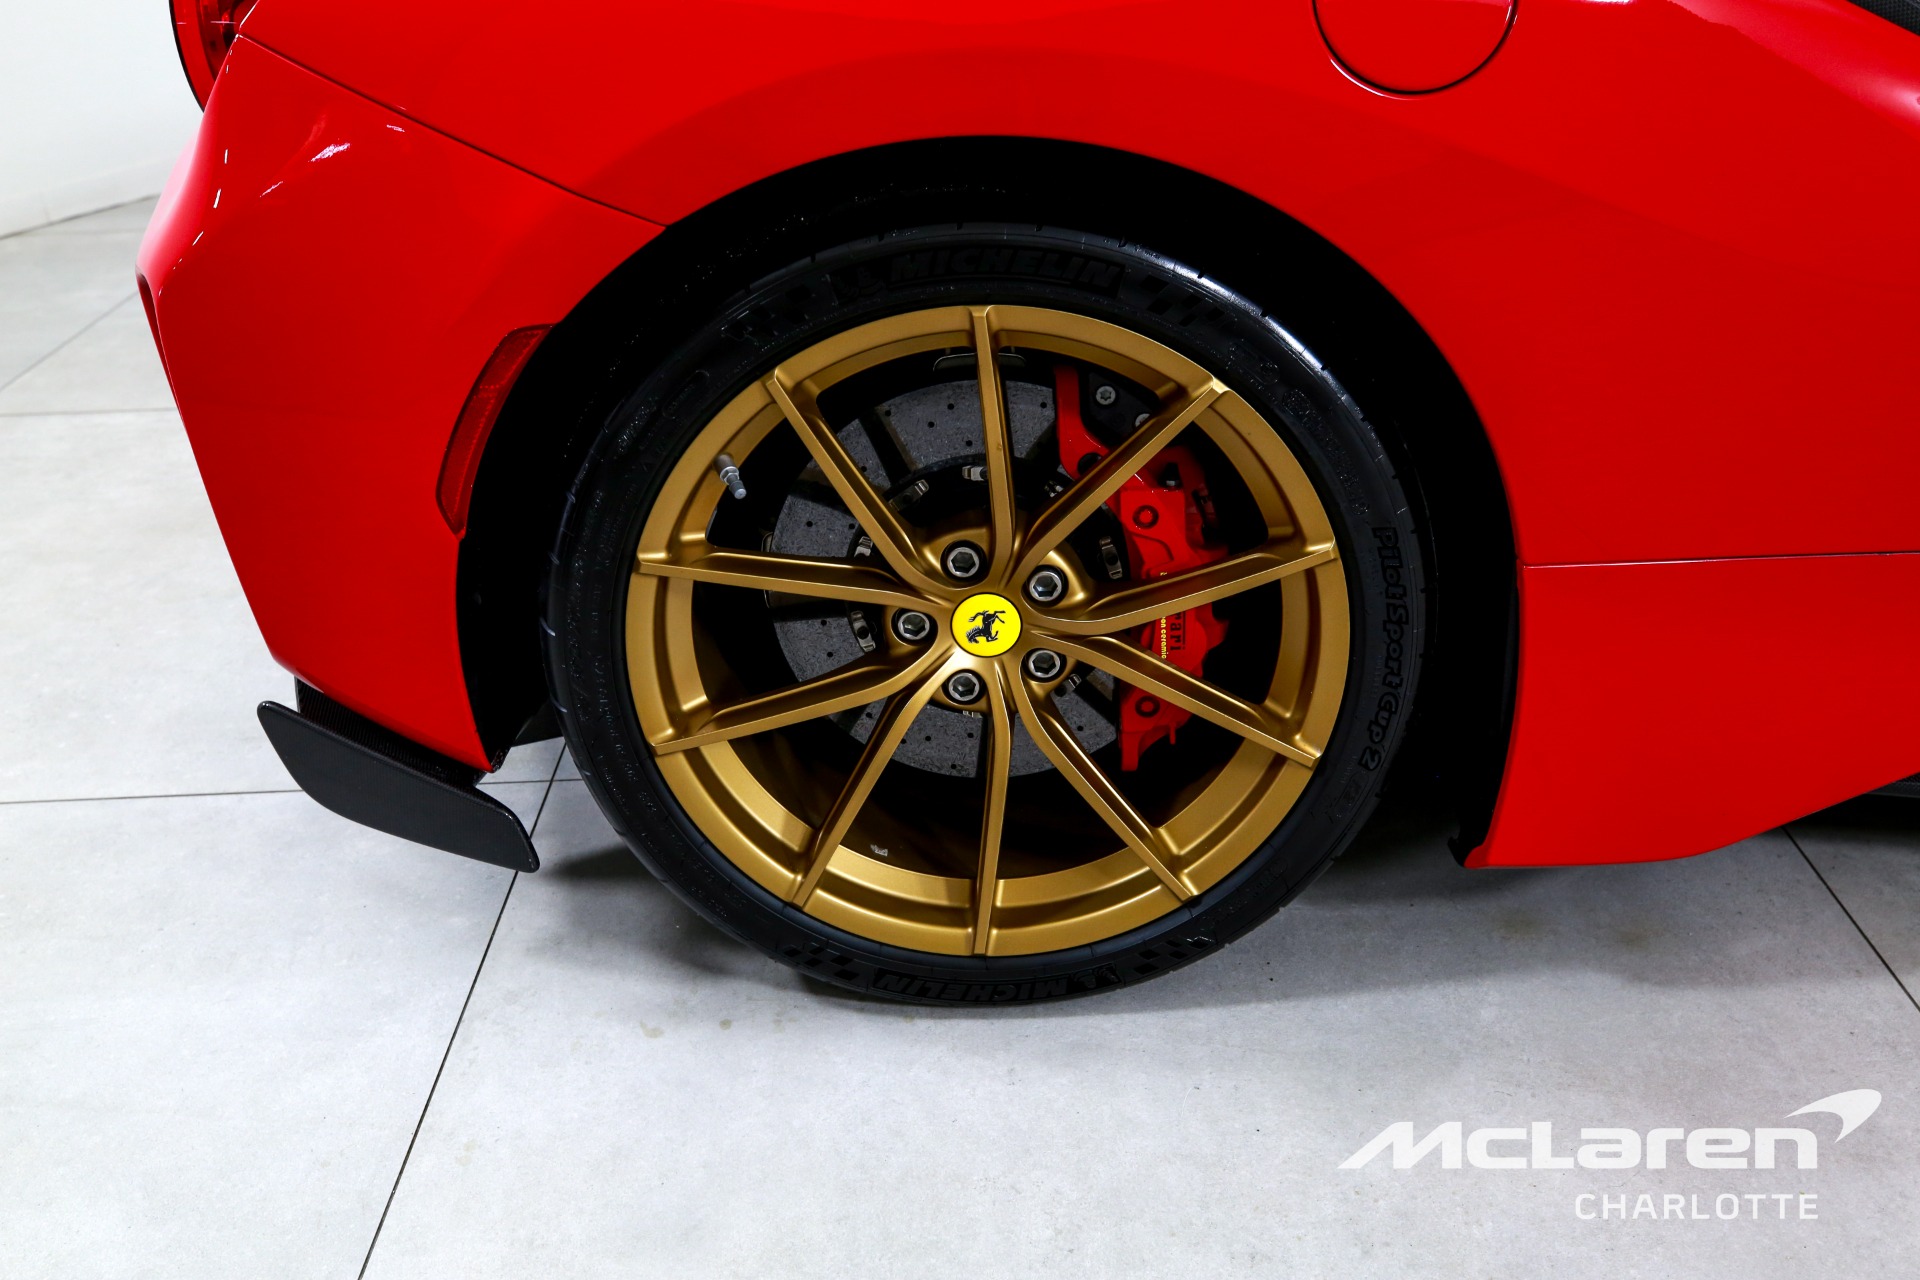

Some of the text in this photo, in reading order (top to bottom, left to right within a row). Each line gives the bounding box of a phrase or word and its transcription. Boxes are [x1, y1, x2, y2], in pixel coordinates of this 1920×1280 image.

[889, 247, 1121, 288] MICHELIN
[1372, 527, 1407, 599] Pilot
[1383, 603, 1409, 688] Sport
[1368, 692, 1399, 744] Cup
[1358, 746, 1382, 771] 2
[873, 970, 1070, 1002] MICHELIN
